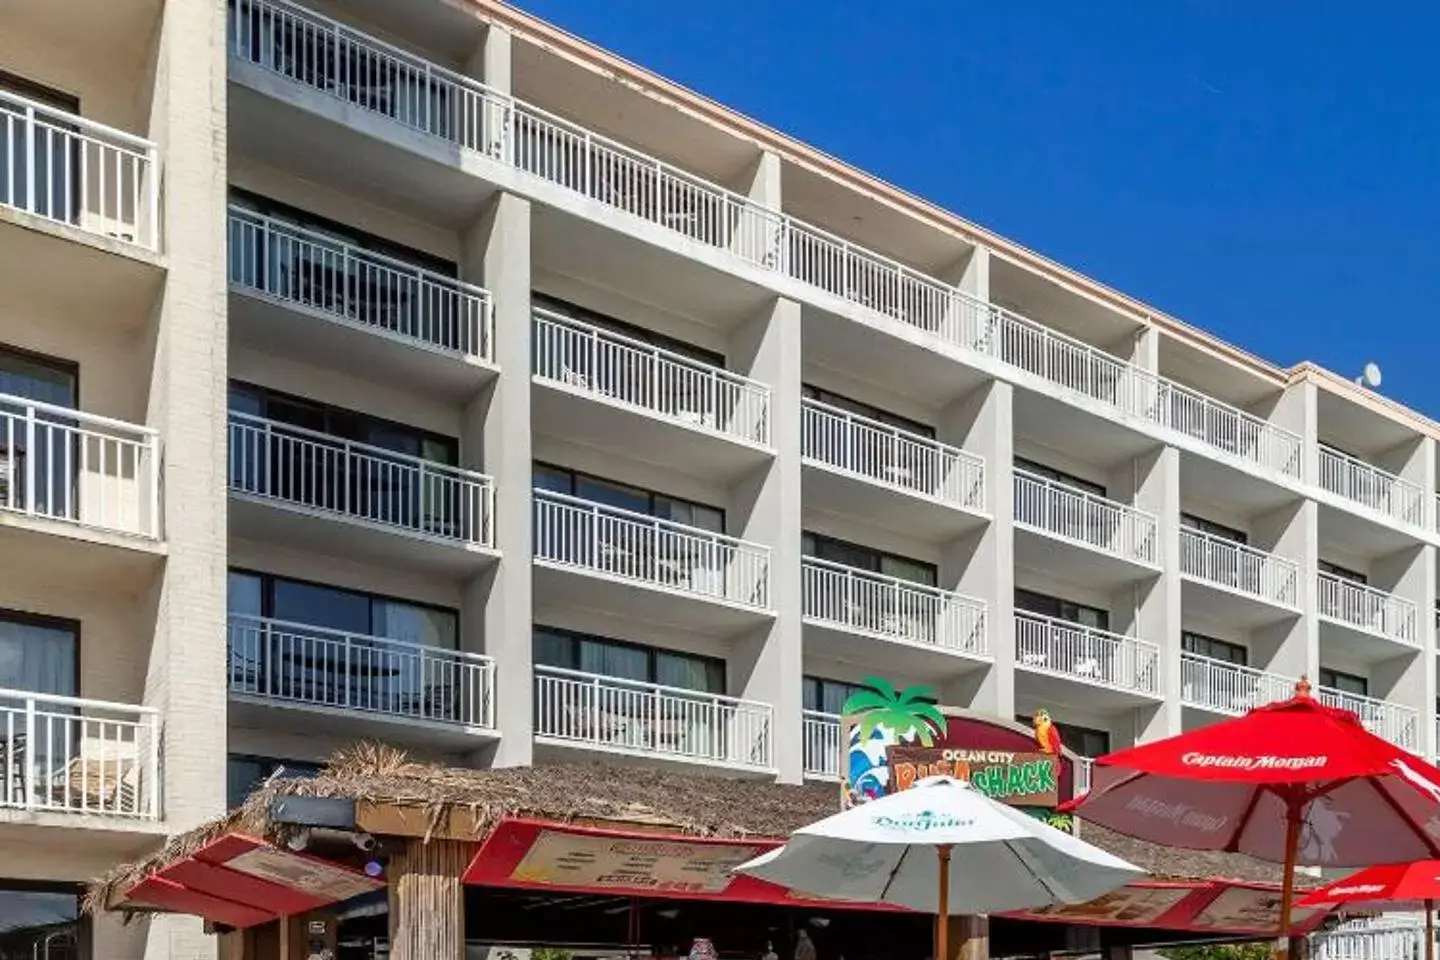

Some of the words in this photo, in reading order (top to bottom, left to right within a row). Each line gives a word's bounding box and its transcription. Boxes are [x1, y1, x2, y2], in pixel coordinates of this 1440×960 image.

[942, 749, 986, 763] OCEAN
[988, 751, 1015, 764] CITY
[1181, 752, 1252, 768] Captain
[1247, 754, 1328, 771] Morgan
[973, 760, 1056, 798] SHACK
